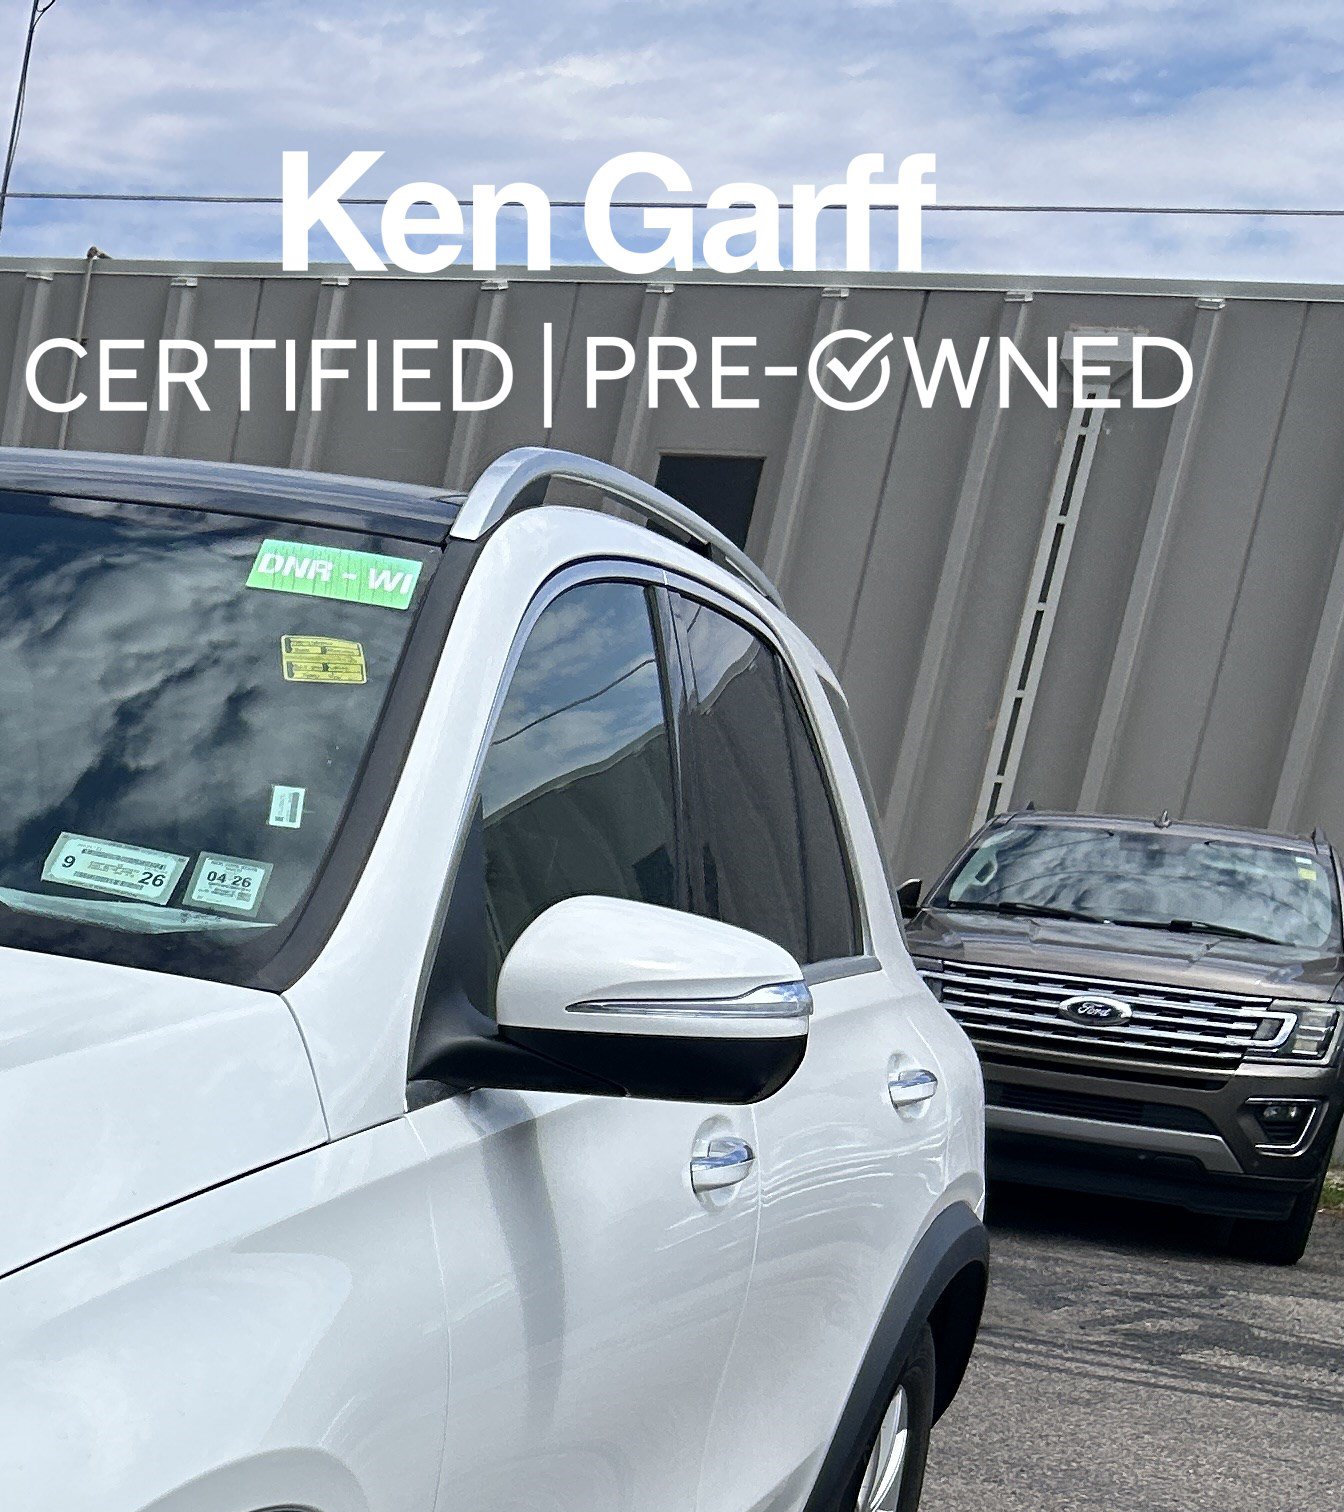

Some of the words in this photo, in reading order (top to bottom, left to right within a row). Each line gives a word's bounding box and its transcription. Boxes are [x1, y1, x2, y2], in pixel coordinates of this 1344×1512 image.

[257, 552, 333, 582] DNR
[369, 567, 412, 594] WI
[62, 855, 76, 868] 9
[138, 871, 166, 887] 26
[207, 871, 226, 884] 04
[231, 875, 252, 888] 26
[1077, 1002, 1112, 1017] Ford
